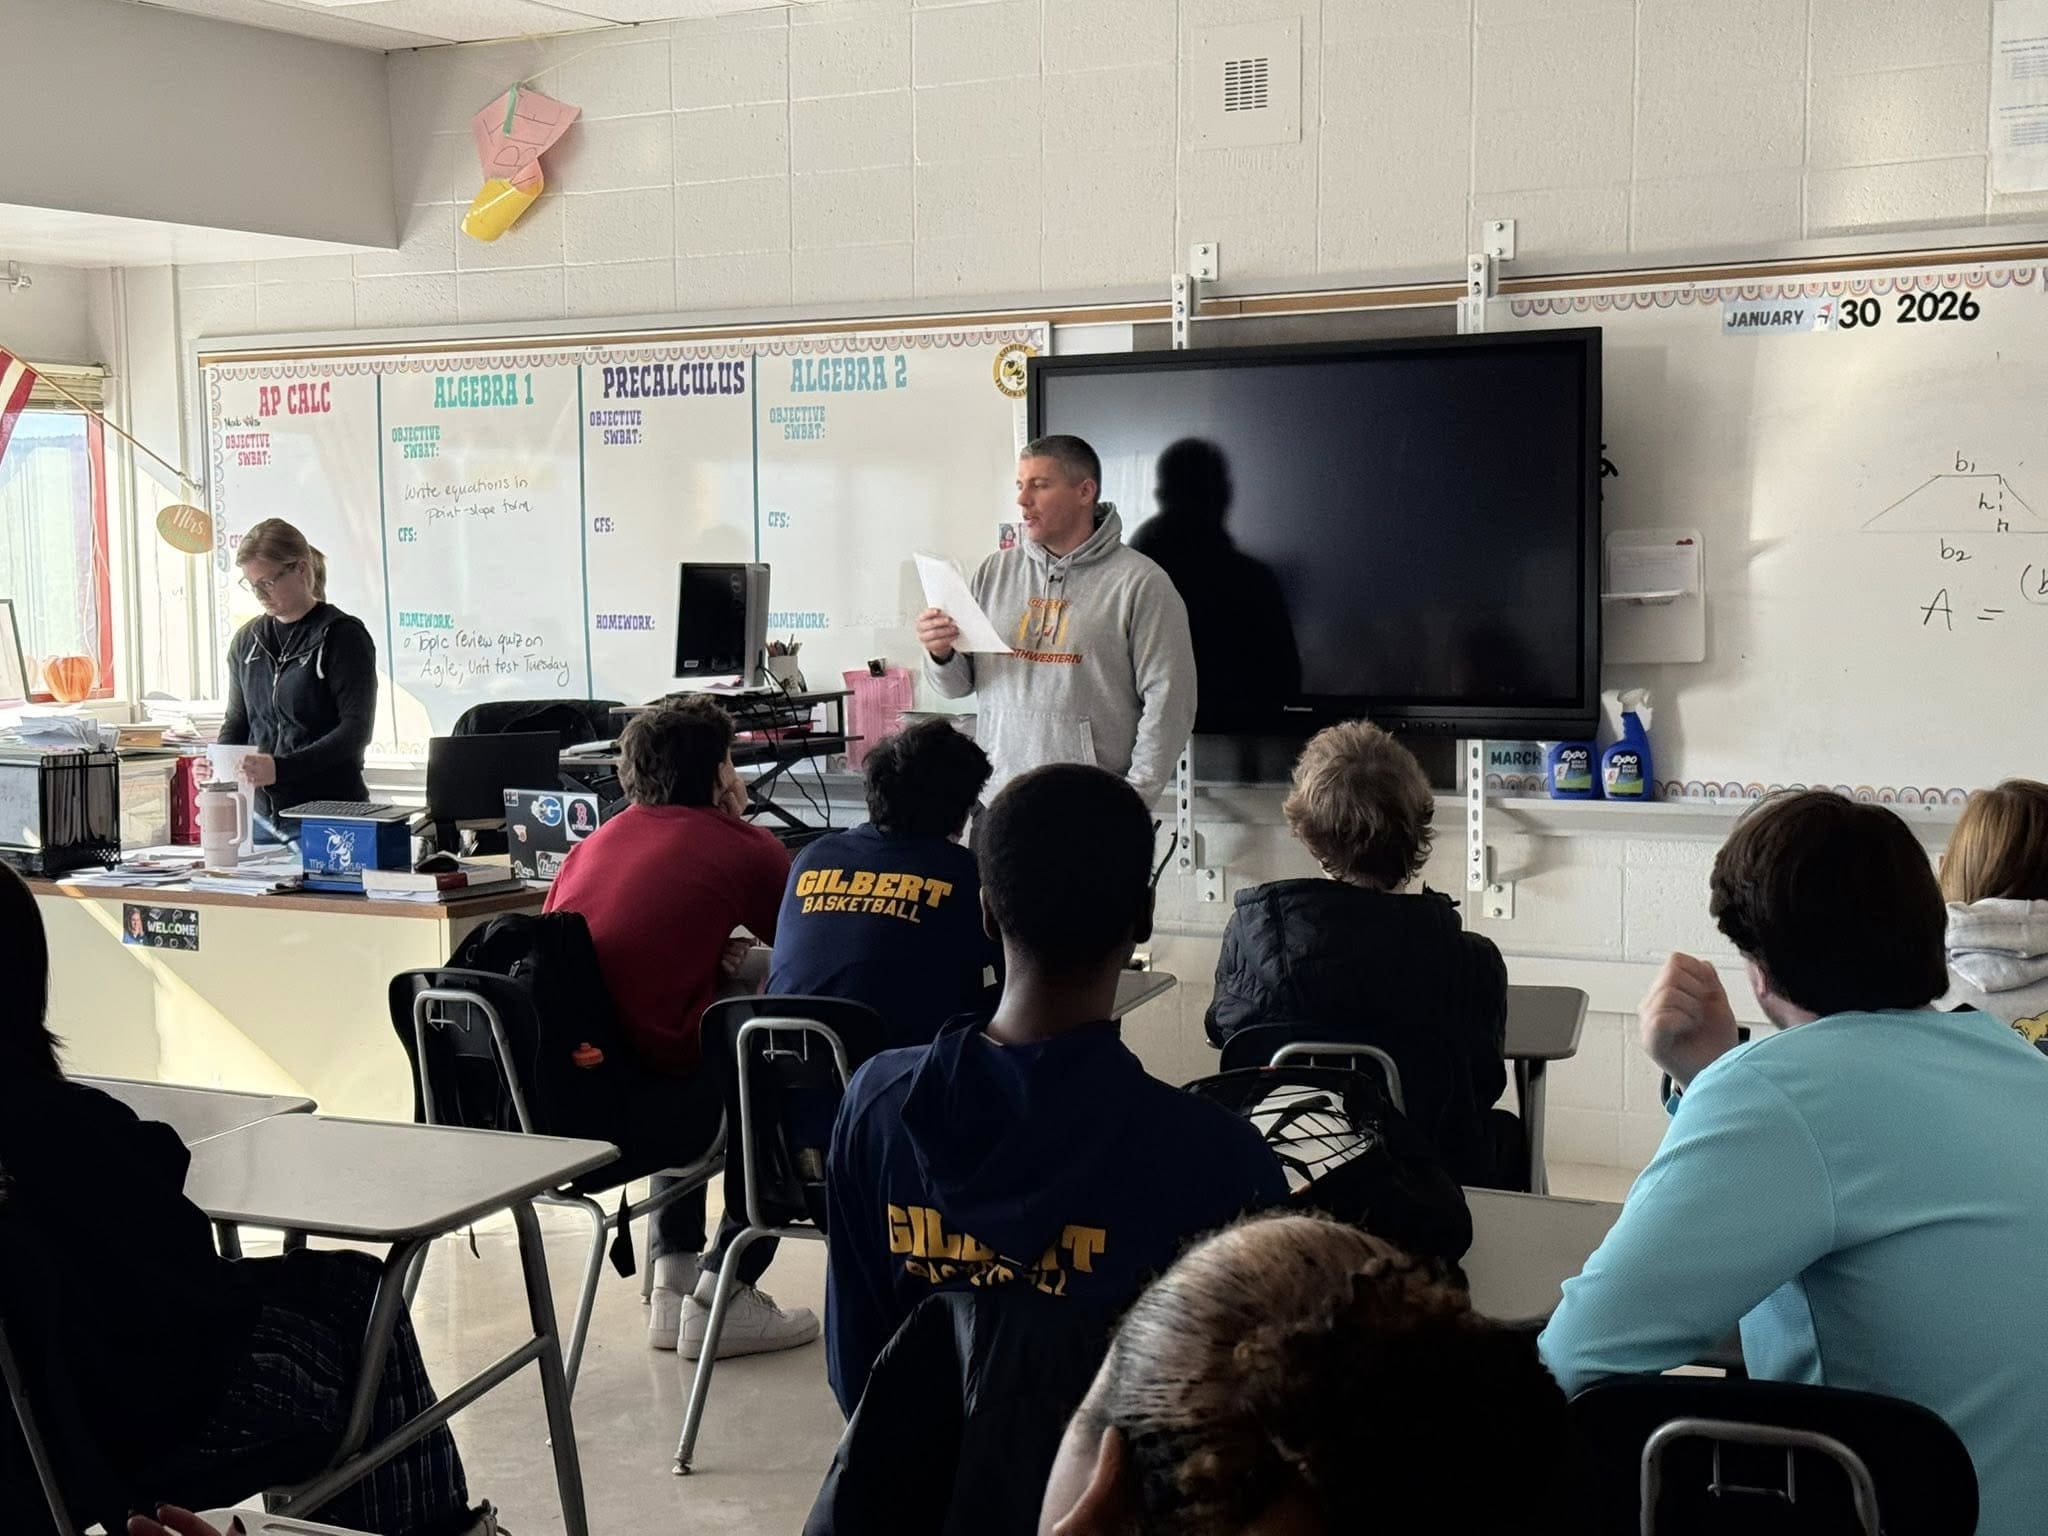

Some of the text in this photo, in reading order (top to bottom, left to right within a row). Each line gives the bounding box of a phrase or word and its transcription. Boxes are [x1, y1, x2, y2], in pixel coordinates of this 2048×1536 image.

[1727, 291, 1980, 329] JANUARY 30 2026
[603, 361, 745, 399] PRECALCULUS
[790, 355, 907, 393] ALGEBRA 2
[259, 381, 331, 417] AP CALC
[434, 373, 535, 409] ALGEBRA 1
[590, 410, 642, 427] OBJECTIVE
[769, 406, 826, 423] OBJECTIVE
[391, 425, 441, 443] OBJECTIVE
[603, 429, 642, 445] SWBAT:
[784, 423, 826, 440] SWBAT:
[225, 433, 270, 449] OBJECTIVE
[238, 451, 271, 466] SWBAT:
[403, 443, 440, 459] SWBAT:
[404, 476, 529, 502] Write equations in
[593, 517, 615, 533] CFS:
[768, 511, 791, 529] CFS:
[398, 527, 417, 542] CFS:
[1920, 588, 1953, 631] A
[399, 612, 454, 629] HOMEWORK:
[595, 614, 655, 631] HOMEWORK:
[414, 630, 543, 656] Topic review quiz on
[468, 656, 490, 674] Unit
[495, 657, 519, 674] test
[523, 653, 570, 688] Tuesday
[1490, 750, 1542, 766] MARCH
[1561, 750, 1588, 762] EXPO
[1611, 755, 1638, 766] EXPO
[796, 868, 953, 909] GILBERT
[801, 895, 922, 924] BASKETBALL
